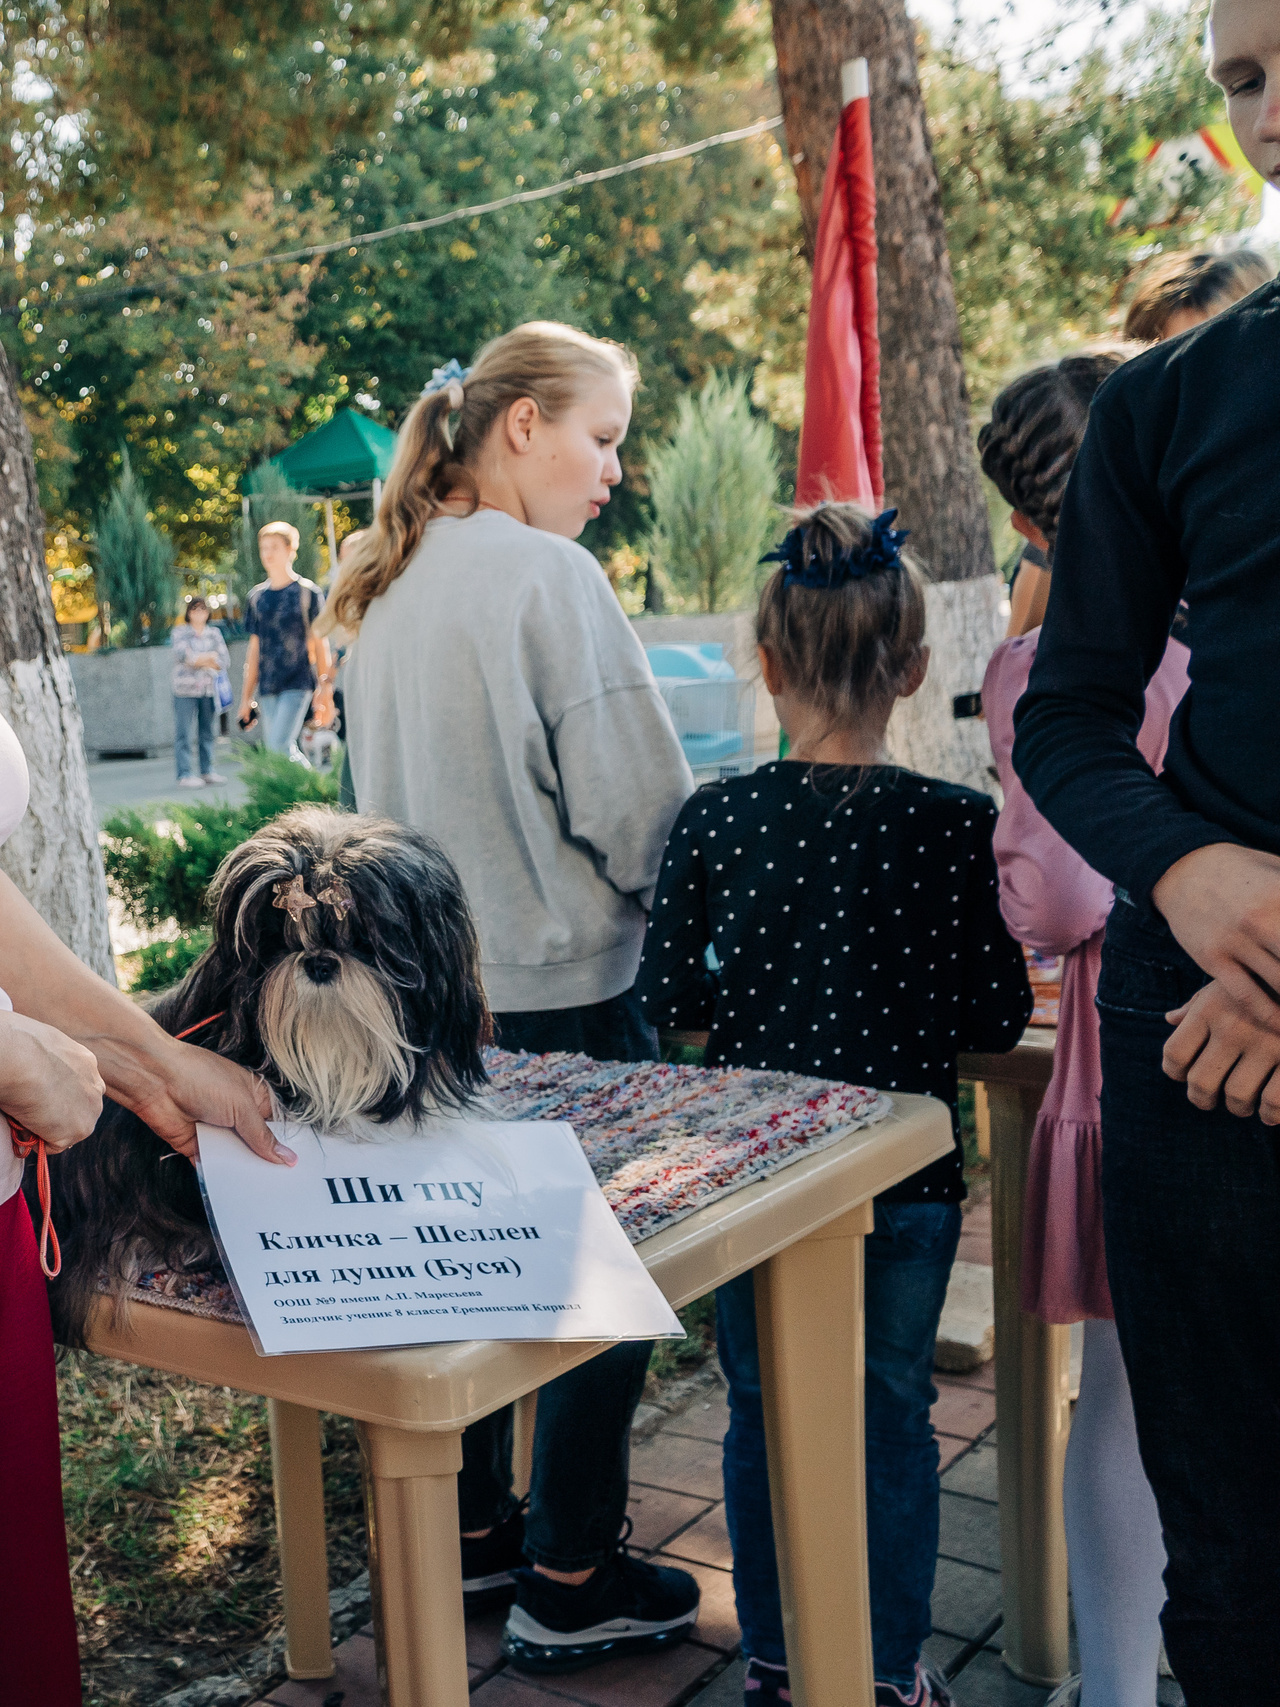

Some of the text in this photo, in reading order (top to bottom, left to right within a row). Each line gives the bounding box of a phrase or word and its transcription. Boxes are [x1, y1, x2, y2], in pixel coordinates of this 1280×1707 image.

[322, 1176, 484, 1207] Ши тцу
[256, 1231, 383, 1251] Кличка
[412, 1224, 541, 1245] Шеллен
[263, 1255, 522, 1288] для души (Буся)
[273, 1290, 483, 1308] ООШ №9 имени А.П. Маресьева
[280, 1303, 581, 1324] Заводчик ученик 8 класса Ереминский Кирилл
